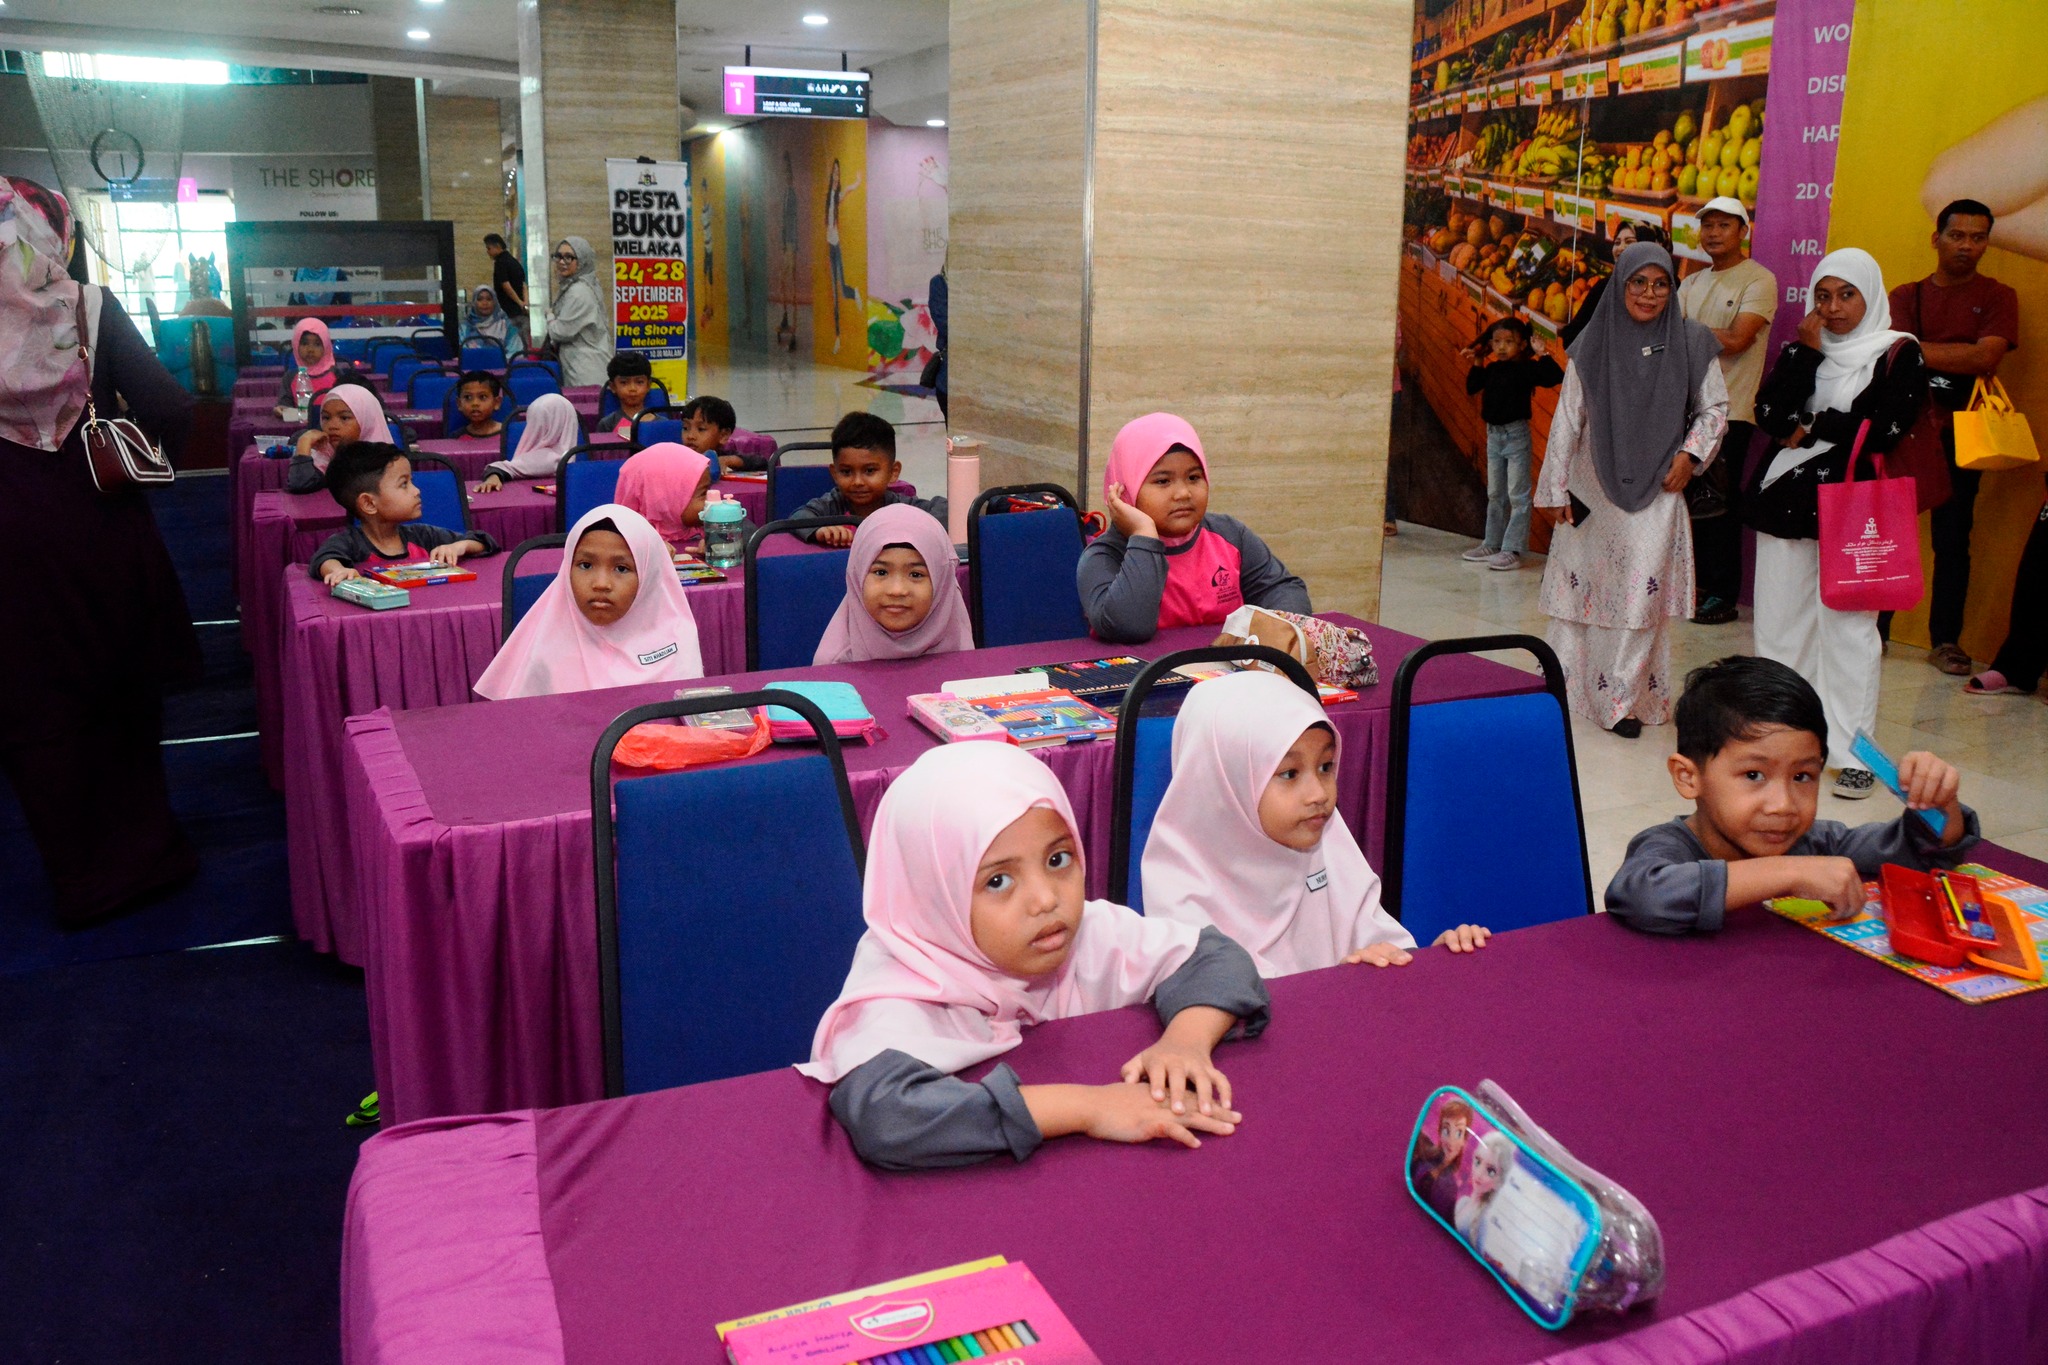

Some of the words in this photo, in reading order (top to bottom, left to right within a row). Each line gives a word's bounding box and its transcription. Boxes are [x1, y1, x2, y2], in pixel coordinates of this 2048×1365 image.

[735, 88, 742, 106] 1
[260, 168, 300, 188] THE
[309, 168, 376, 188] SHORE
[615, 190, 680, 210] PESTA
[1795, 183, 1819, 200] 2D
[612, 211, 685, 238] BUKU
[613, 240, 683, 257] MELAKA
[1791, 240, 1822, 255] MR.
[614, 286, 684, 303] SEPTEMBER
[629, 305, 669, 321] 2025
[616, 325, 641, 337] The
[643, 324, 684, 336] Shore
[631, 338, 668, 347] Melaka
